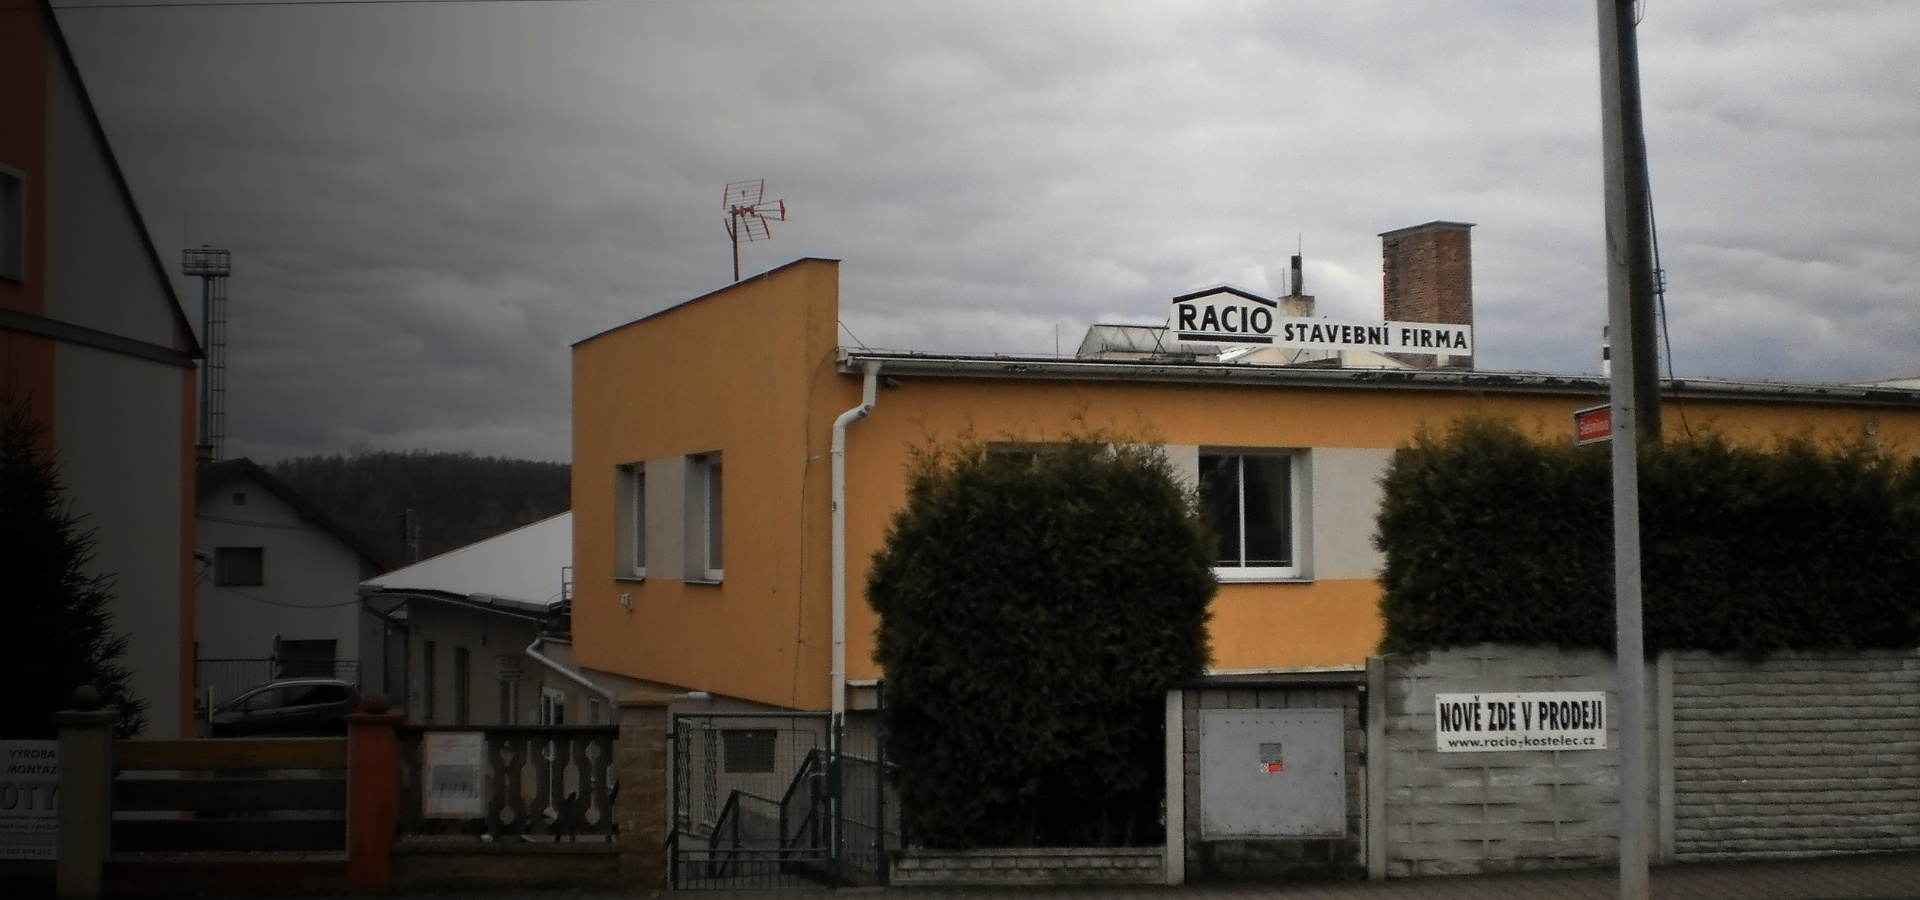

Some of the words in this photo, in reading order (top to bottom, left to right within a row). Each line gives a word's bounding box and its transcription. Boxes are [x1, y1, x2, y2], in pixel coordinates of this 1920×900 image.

[1178, 303, 1273, 334] RACIO
[1285, 322, 1389, 346] STAVEBNÍ
[1401, 328, 1467, 349] FIRMA
[1440, 694, 1482, 732] NOVĚ
[1487, 702, 1516, 731] ZDE
[1521, 701, 1532, 731] V
[1538, 700, 1603, 731] PRODEJI
[1448, 735, 1596, 748] www.racio-kostelec.cz
